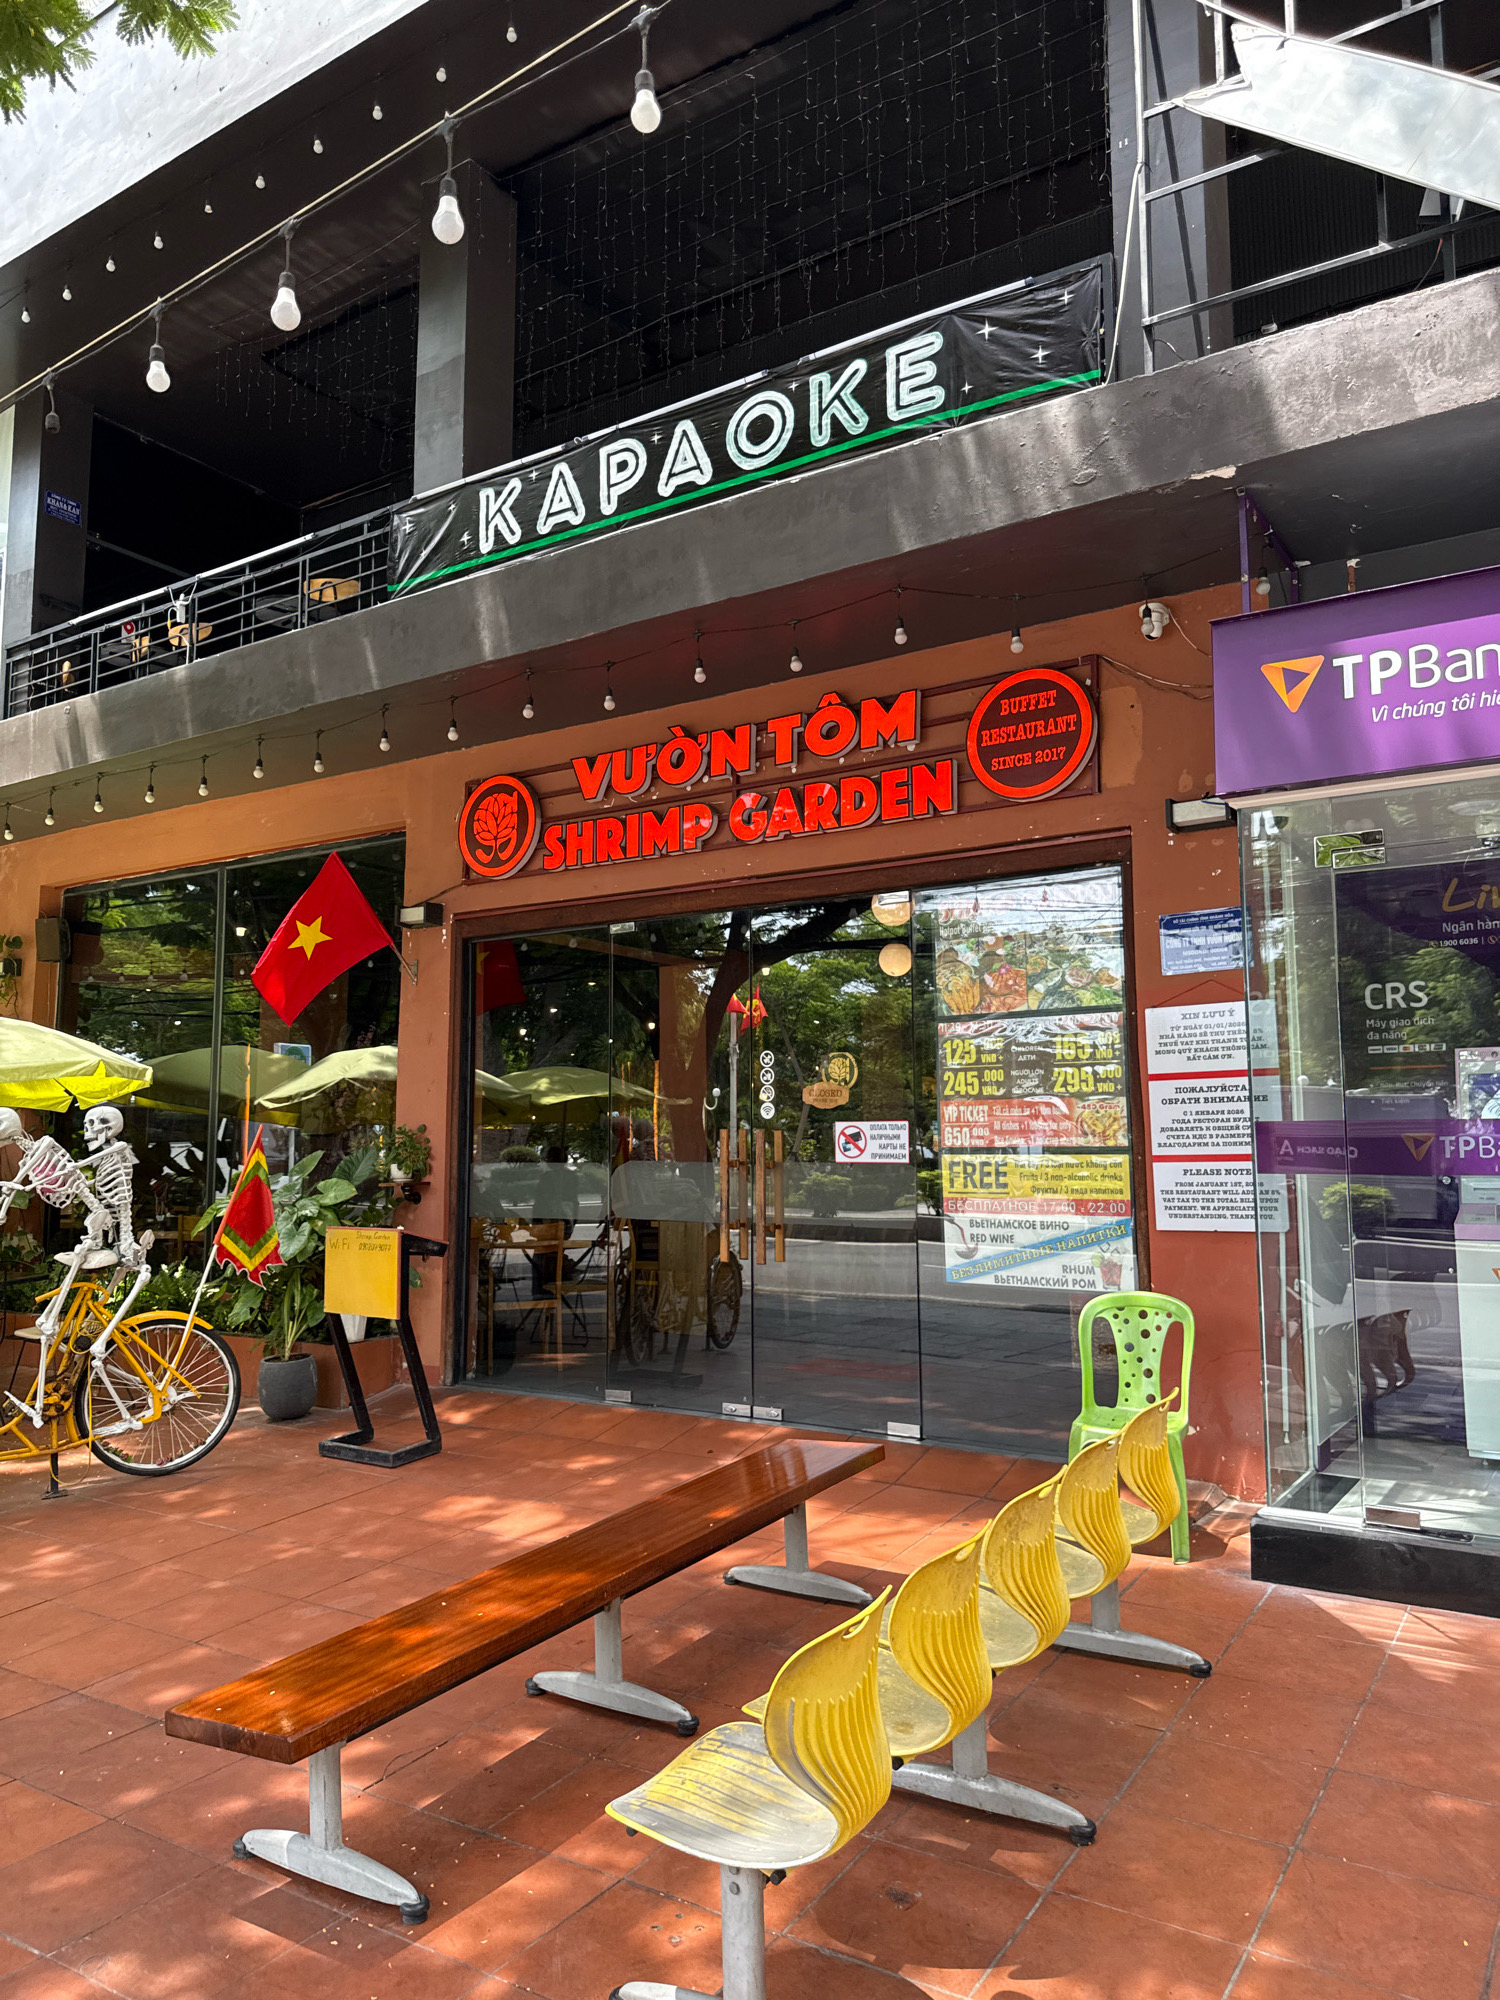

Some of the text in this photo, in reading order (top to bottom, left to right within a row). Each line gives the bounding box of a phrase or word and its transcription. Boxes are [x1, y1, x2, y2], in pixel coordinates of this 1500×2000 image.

[1000, 690, 1057, 716] BUFFET
[1371, 705, 1388, 722] Vì
[1392, 699, 1446, 720] chúng
[1451, 692, 1476, 711] tôi
[981, 714, 1077, 747] RESTAURANT
[571, 689, 921, 802] VƯỜN TÔM
[991, 746, 1066, 771] SINCE 2017
[542, 758, 958, 870] SHRIMP GARDEN
[1442, 921, 1474, 934] Ngân
[1364, 980, 1429, 1010] CRS
[1181, 1007, 1235, 1020] XIN LƯU Ý
[1366, 1016, 1435, 1029] Máy giao dịch
[1367, 1030, 1407, 1040] đa năng
[943, 1038, 977, 1064] 125
[1018, 1054, 1036, 1062] ДЕТИ
[944, 1069, 1004, 1095] 245 .000
[1053, 1067, 1094, 1093] 295
[809, 1090, 842, 1098] CLOSED
[1161, 1098, 1201, 1106] ОБРАТИ
[944, 1105, 988, 1122] VIP TICKET
[944, 1127, 970, 1146] 650
[1438, 1135, 1500, 1159] TPB
[949, 1160, 1008, 1190] FREE
[1020, 1172, 1123, 1182] Fruits 3 non-alcoholic drinks
[1183, 1168, 1252, 1176] PLEASE NOTE
[1030, 1186, 1058, 1196] Фрукты
[1064, 1186, 1068, 1194] 3
[1090, 1187, 1124, 1195] напитков
[948, 1200, 1126, 1214] БЕСПЛАТНОЕ 17:00 22:00
[970, 1219, 1070, 1230] ВЬЕТНАМСКОЕ ВИНО
[970, 1234, 1014, 1244] RED WINE
[952, 1224, 1127, 1280] БЕЗЛИМИТНЫЕ НАПИТКИ
[1062, 1264, 1096, 1275] RHUM
[994, 1274, 1096, 1289] ВЬЕТНАМСКИЙ РОМ
